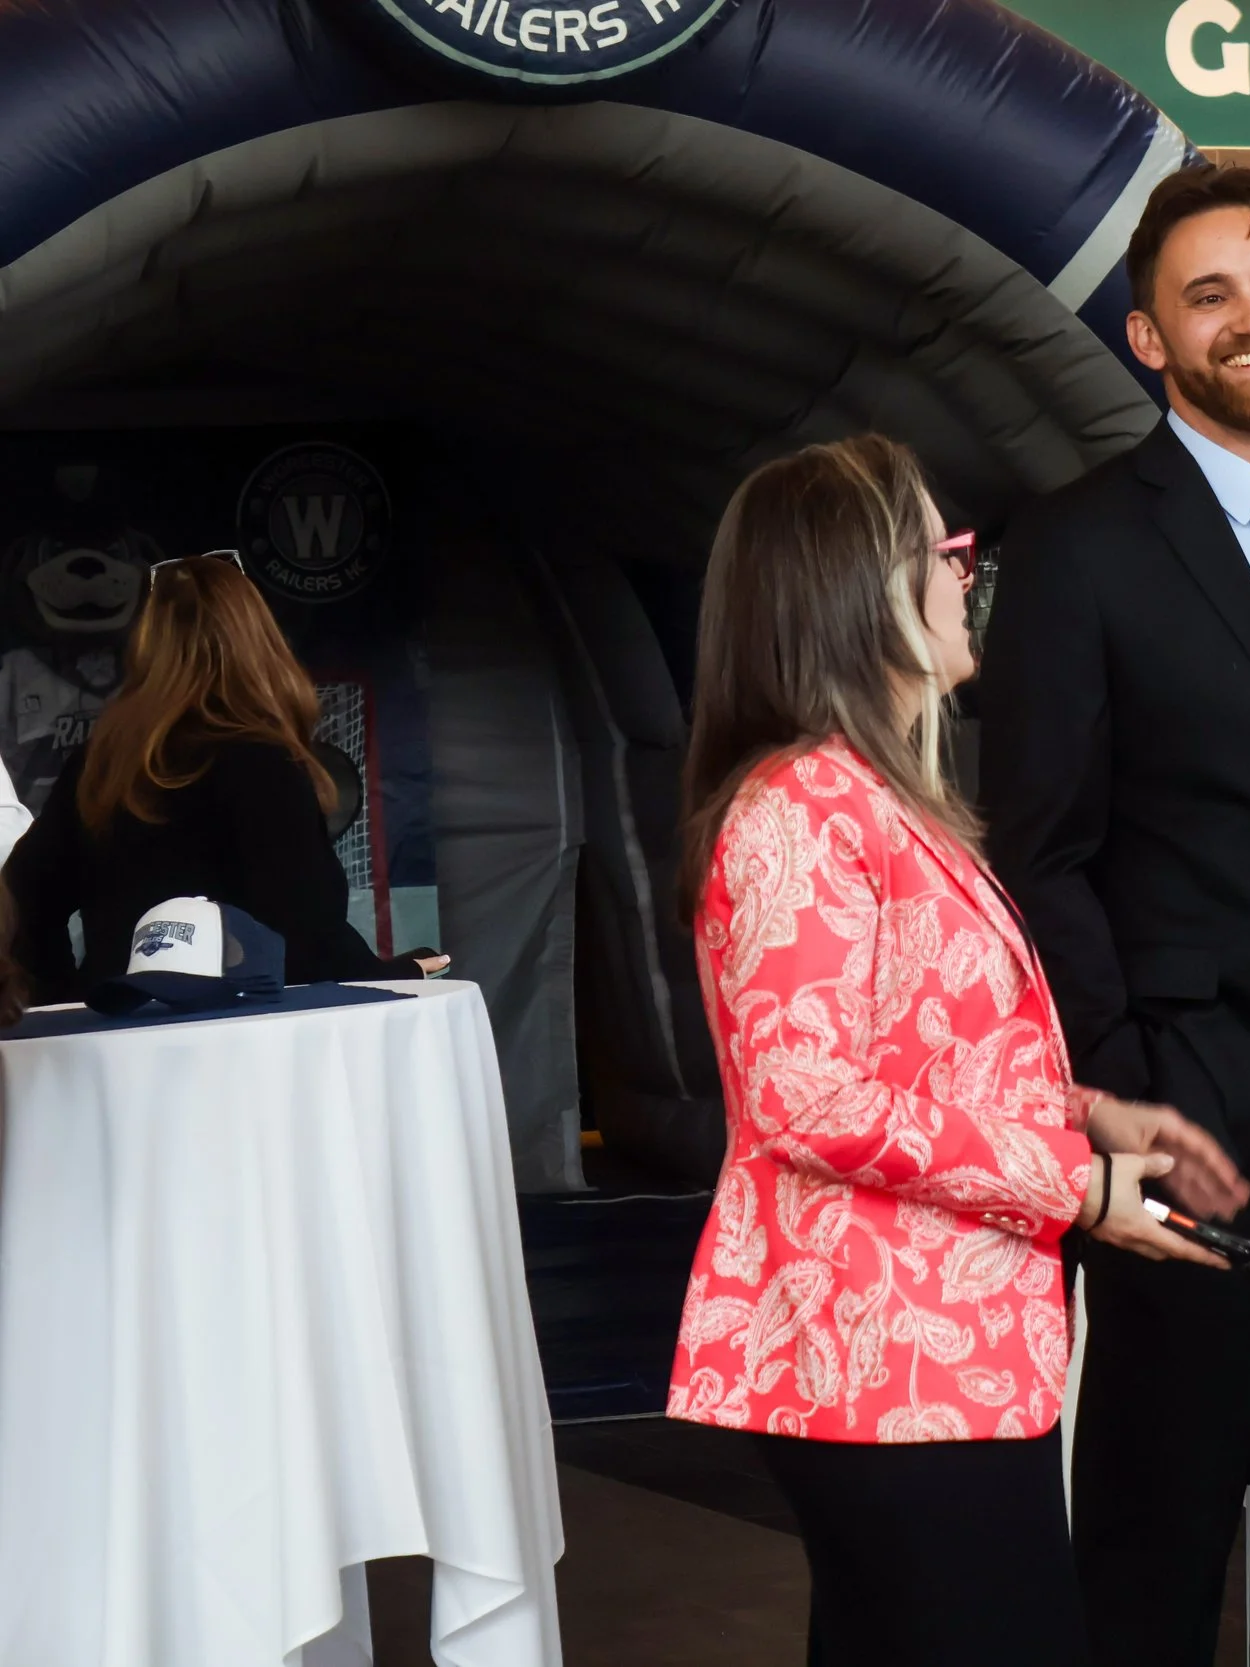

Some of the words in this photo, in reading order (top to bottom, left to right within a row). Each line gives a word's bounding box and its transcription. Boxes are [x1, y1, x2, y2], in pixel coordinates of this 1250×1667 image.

[424, 0, 627, 53] AILERS
[281, 495, 347, 560] W
[264, 558, 343, 593] RAILERS
